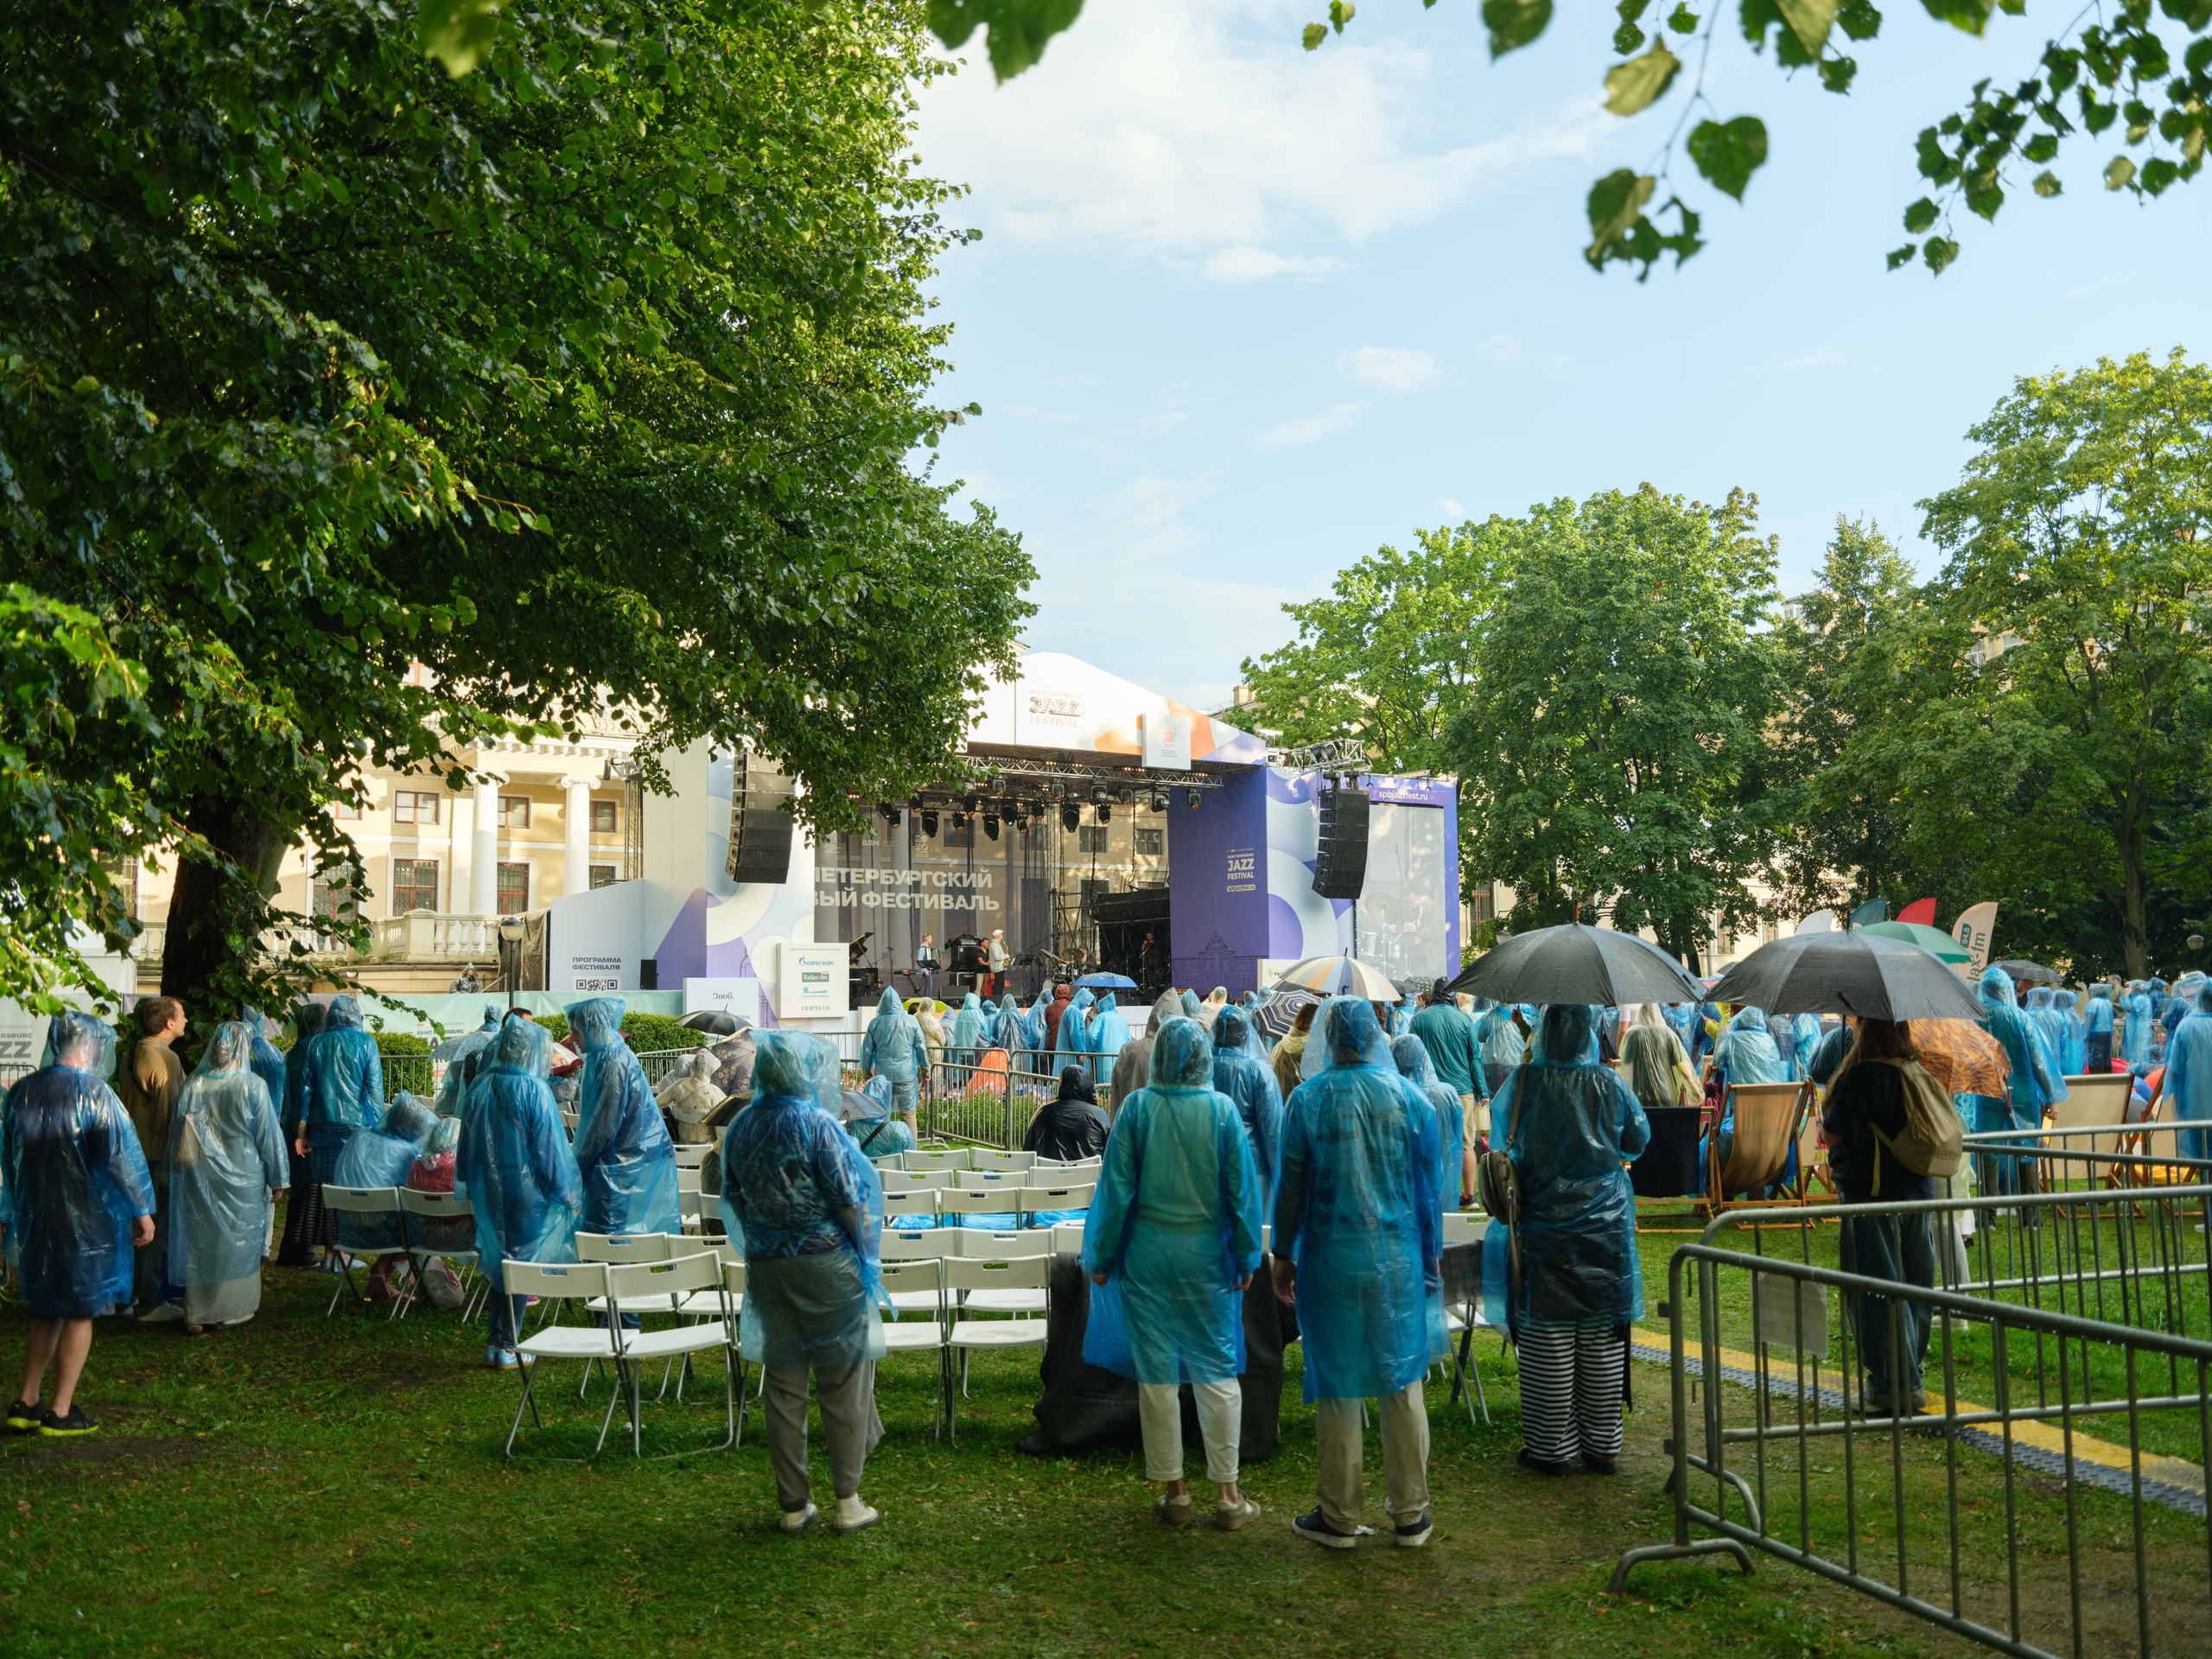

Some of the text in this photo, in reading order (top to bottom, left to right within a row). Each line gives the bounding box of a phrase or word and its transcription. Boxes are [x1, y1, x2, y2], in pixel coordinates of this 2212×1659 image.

[1029, 696, 1084, 716] JAZZ
[1378, 790, 1428, 800] spbjazzfest.ru
[1227, 858, 1255, 872] JAZZ
[861, 891, 1000, 911] ФЕСТИВАЛЬ
[1961, 927, 1971, 944] 94.5
